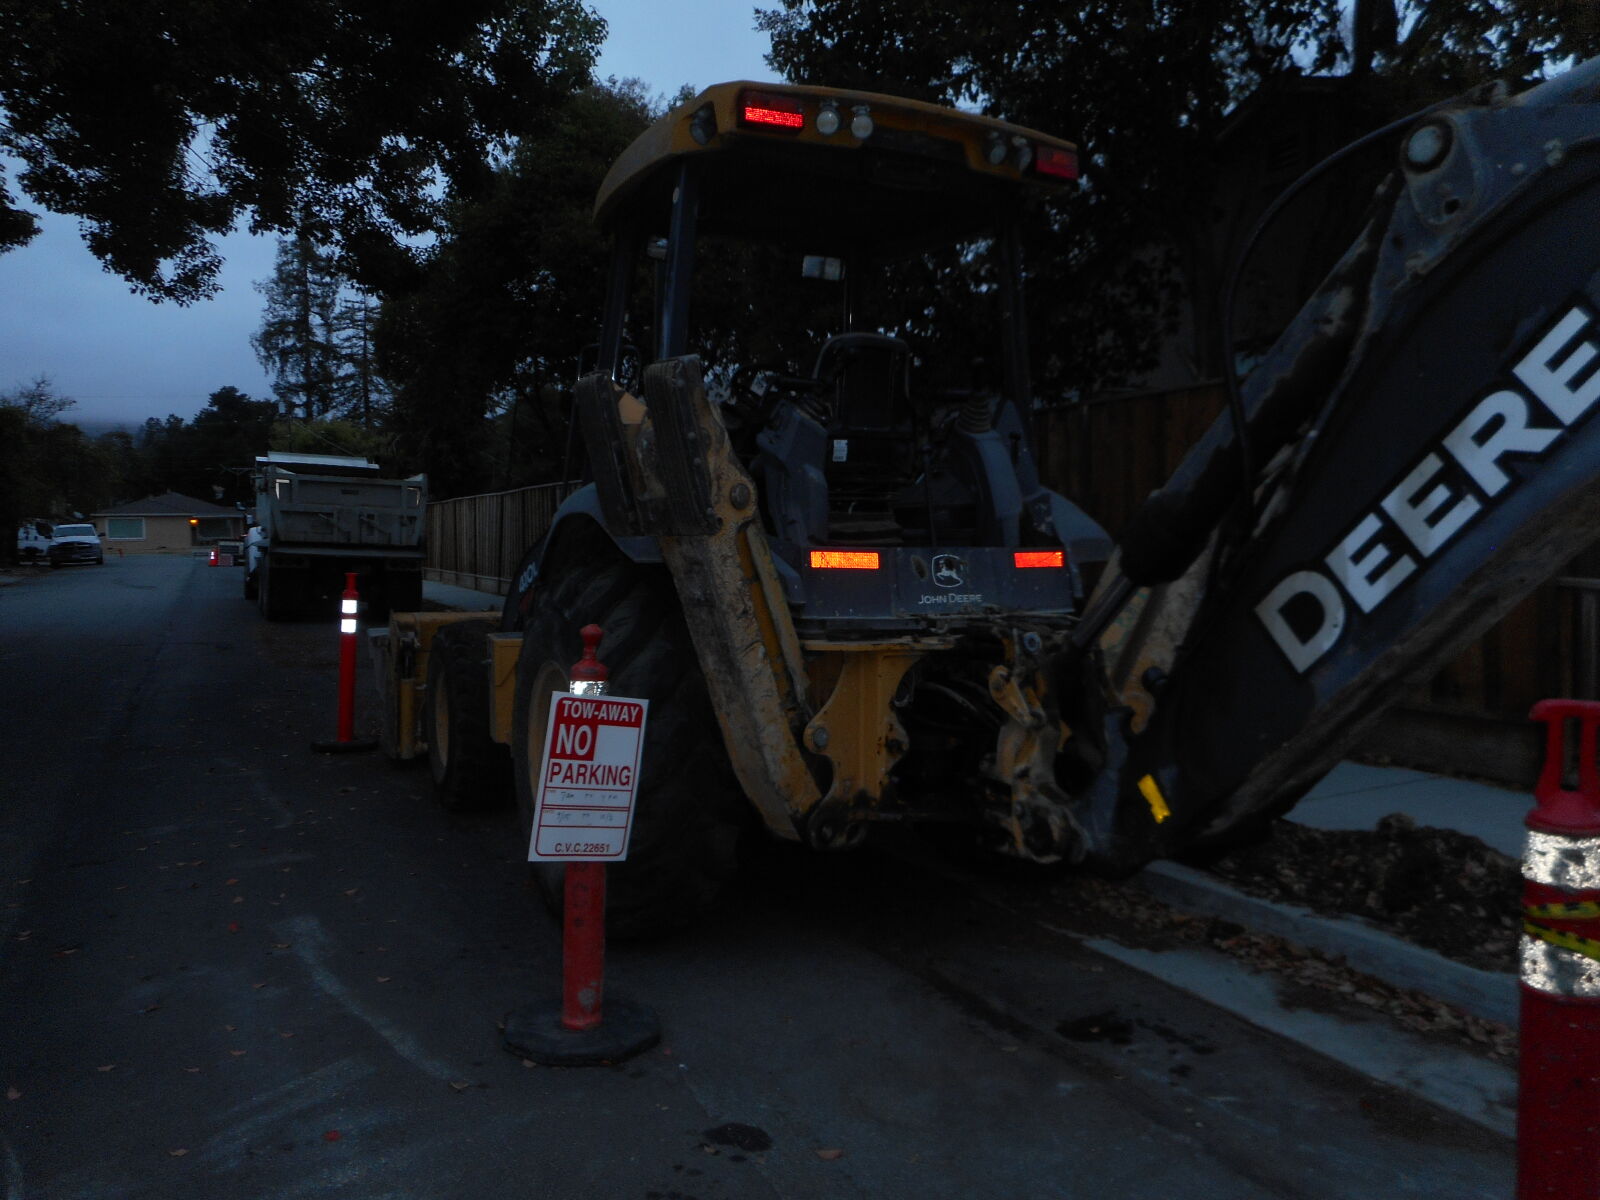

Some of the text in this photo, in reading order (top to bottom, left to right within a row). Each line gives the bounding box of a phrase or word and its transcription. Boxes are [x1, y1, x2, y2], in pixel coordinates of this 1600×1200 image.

[1254, 306, 1600, 675] DEERE
[918, 592, 983, 606] JOHN DEERE
[562, 700, 641, 723] TOW-AWAY
[556, 723, 593, 756] NO
[549, 762, 631, 786] PARKING
[554, 842, 611, 854] C.V.C.22651
